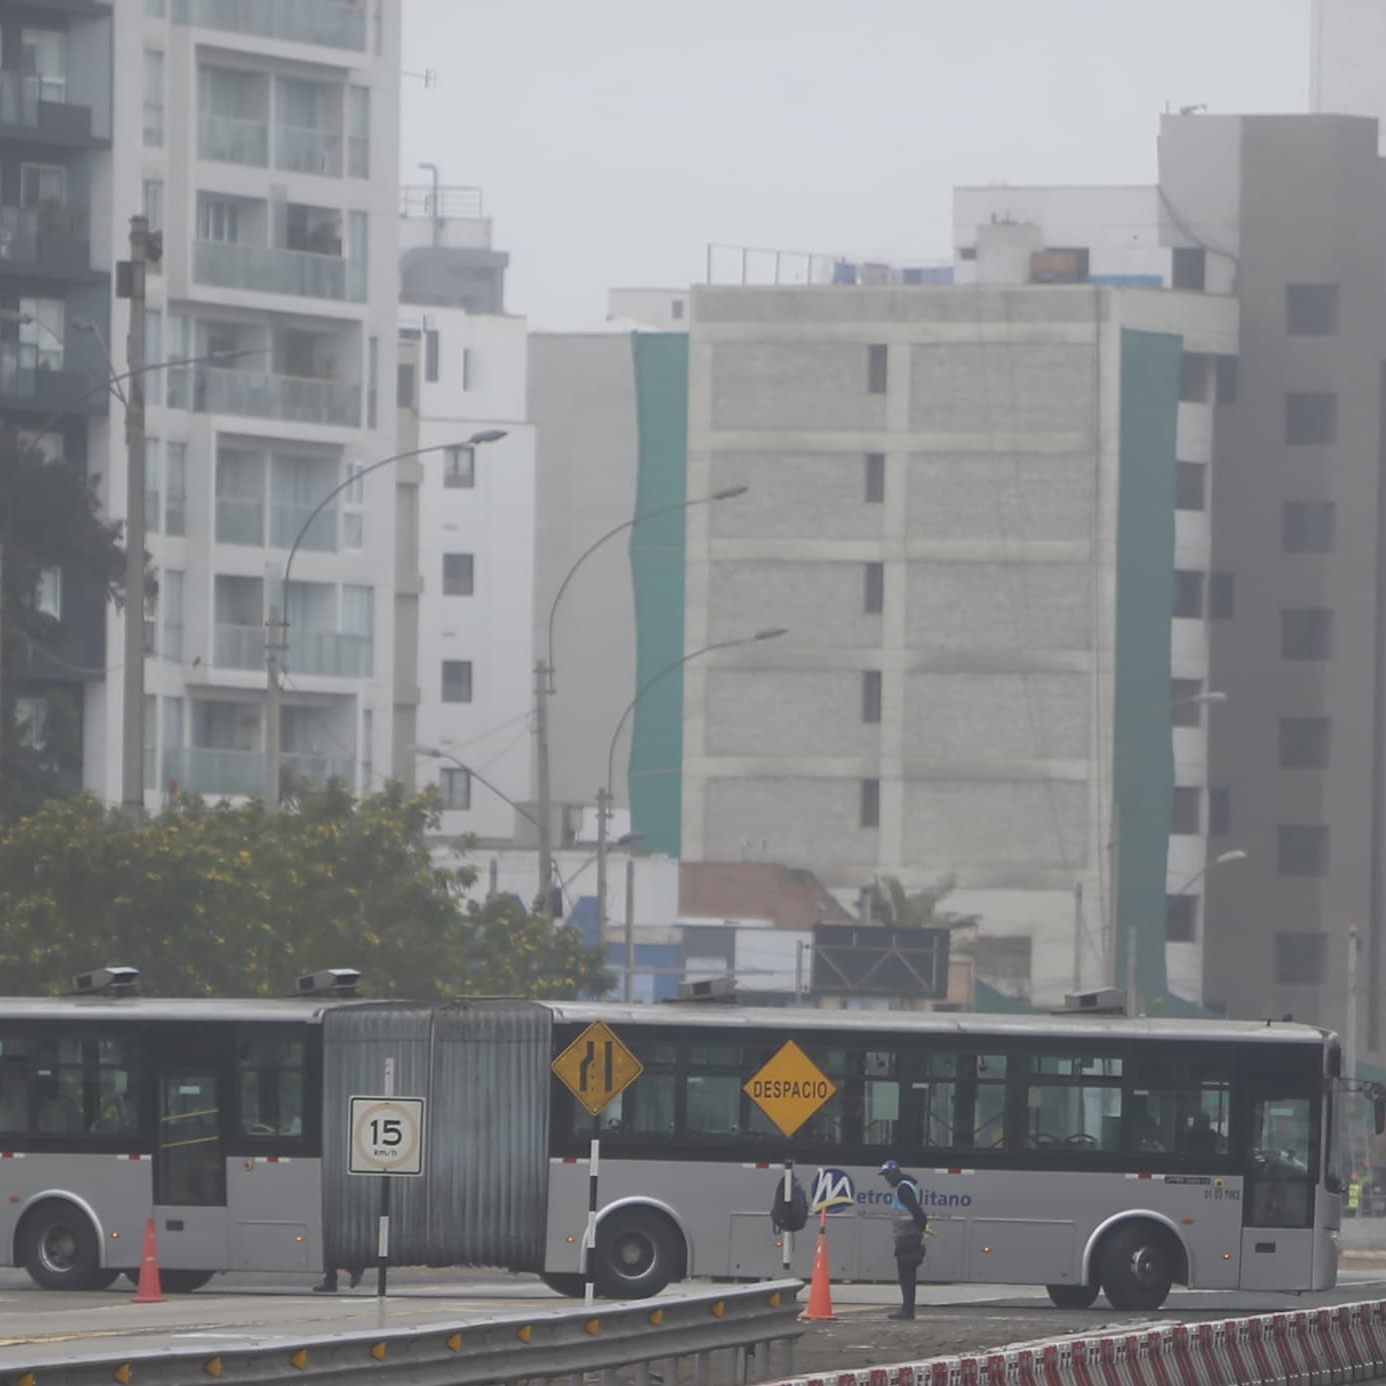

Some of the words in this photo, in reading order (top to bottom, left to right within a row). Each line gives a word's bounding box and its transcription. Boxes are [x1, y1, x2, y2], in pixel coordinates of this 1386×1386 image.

[753, 1080, 828, 1099] DESPACIO
[370, 1119, 403, 1146] 15
[373, 1148, 398, 1157] km/h
